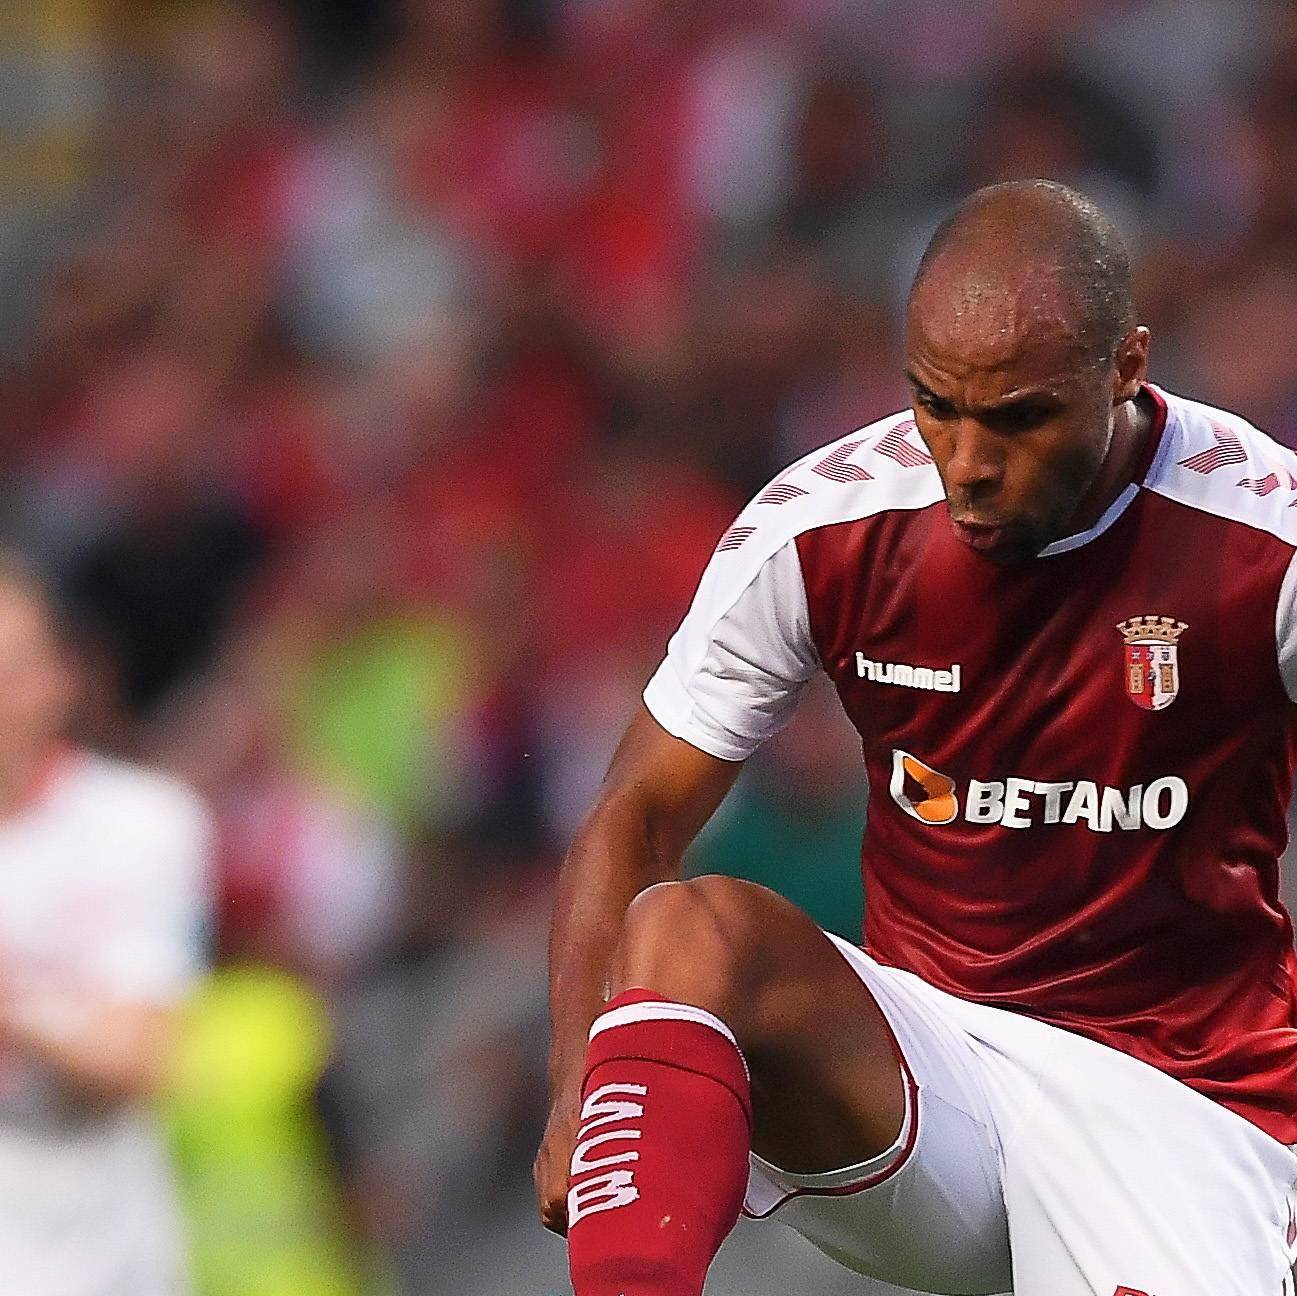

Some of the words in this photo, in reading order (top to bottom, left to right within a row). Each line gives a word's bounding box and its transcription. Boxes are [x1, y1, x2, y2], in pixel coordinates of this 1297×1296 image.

[855, 651, 962, 693] hummel
[964, 775, 1190, 833] BETANO
[566, 1082, 649, 1230] SCB
